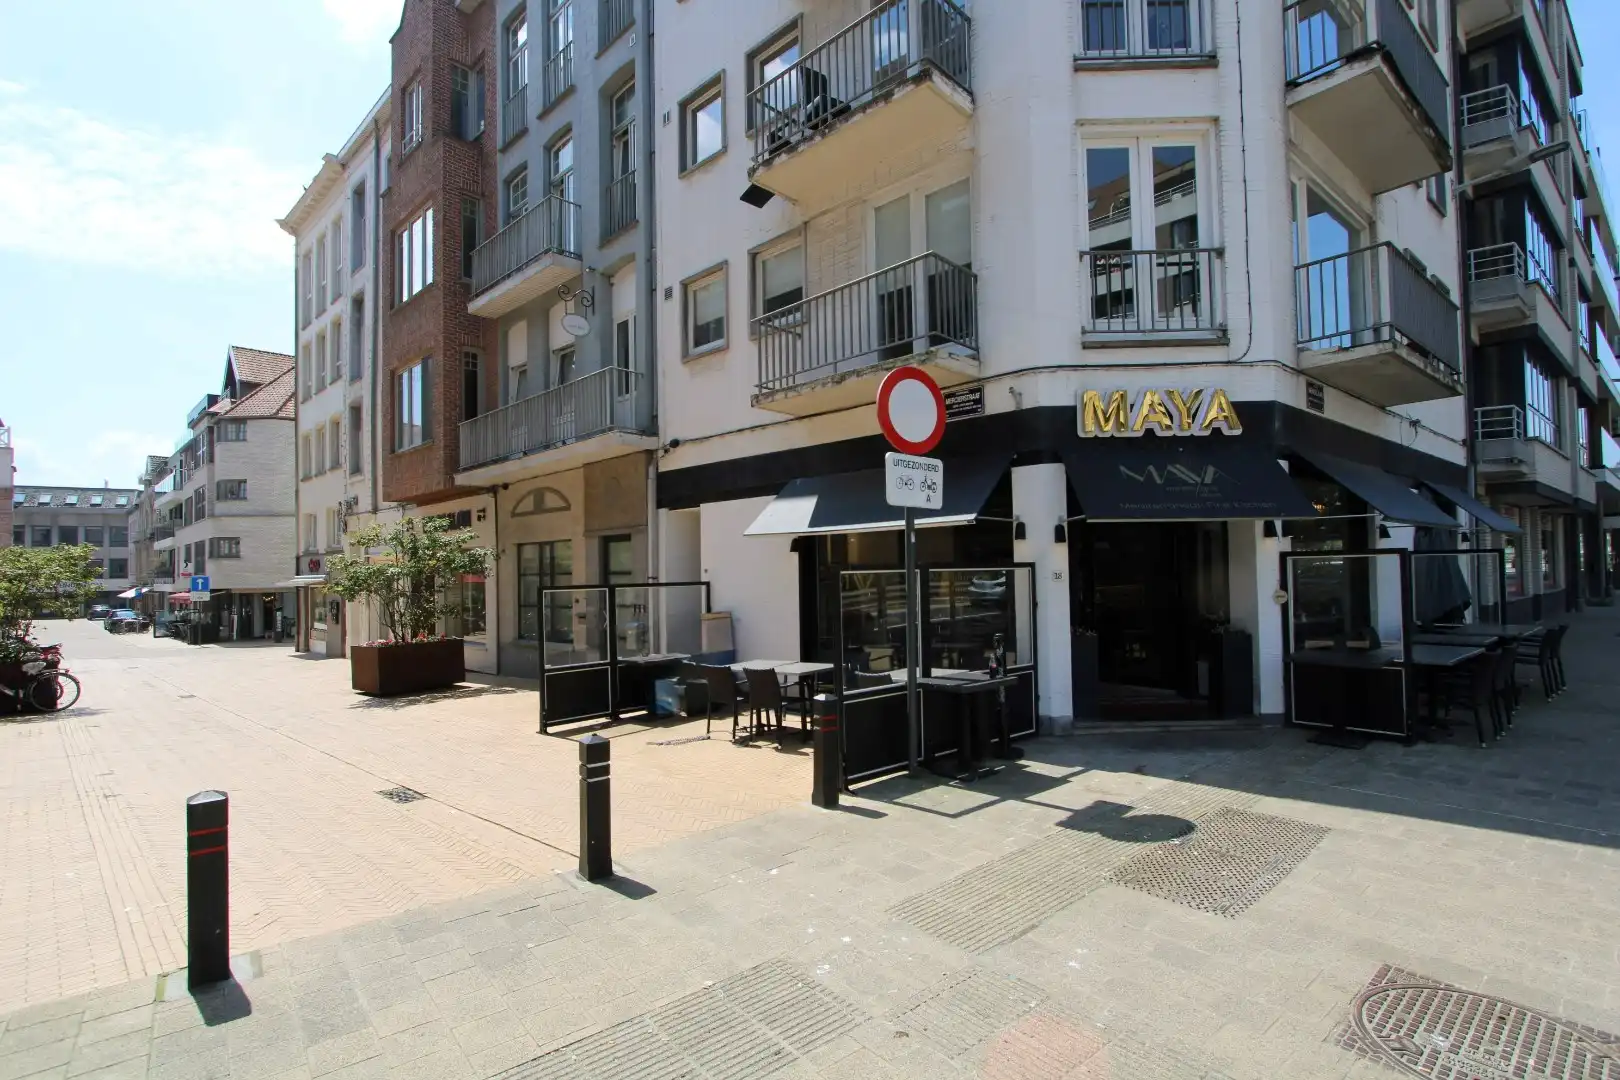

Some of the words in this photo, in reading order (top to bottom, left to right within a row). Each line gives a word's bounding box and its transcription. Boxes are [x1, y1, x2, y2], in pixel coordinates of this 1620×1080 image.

[1081, 388, 1242, 434] MAYA
[893, 458, 940, 473] UITGEZONDERD
[926, 494, 932, 504] A
[1054, 572, 1062, 580] 18
